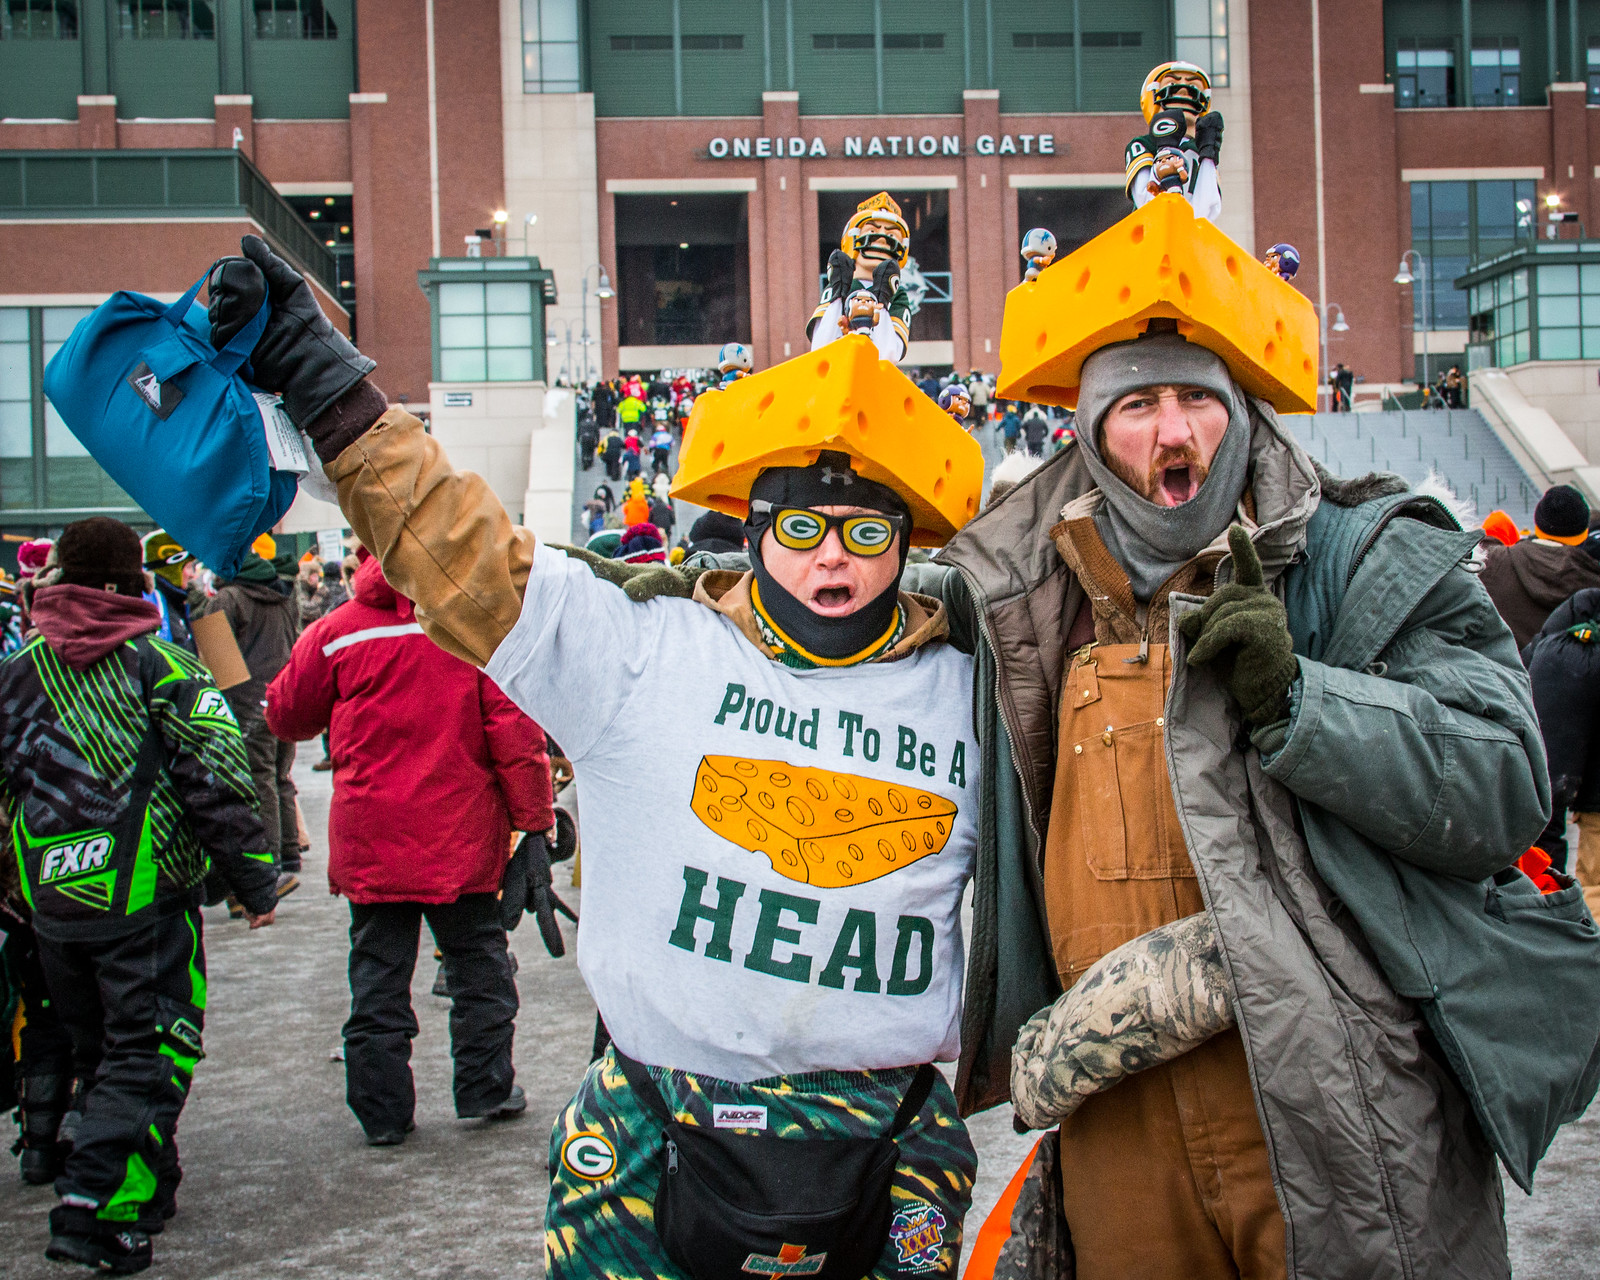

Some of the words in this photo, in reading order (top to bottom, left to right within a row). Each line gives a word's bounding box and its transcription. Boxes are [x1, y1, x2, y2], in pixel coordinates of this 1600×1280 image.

[1152, 119, 1177, 135] G
[709, 137, 827, 157] ONEIDA
[844, 135, 959, 156] NATION
[976, 134, 1054, 155] GATE
[782, 515, 819, 538] G
[851, 522, 888, 545] G
[196, 691, 237, 722] FX
[713, 682, 820, 750] Proud
[838, 710, 880, 762] To
[896, 724, 936, 776] Be
[948, 740, 966, 788] A
[42, 836, 111, 880] FXR
[668, 865, 935, 996] HEAD
[567, 1137, 613, 1175] G
[900, 1224, 940, 1258] XXXI
